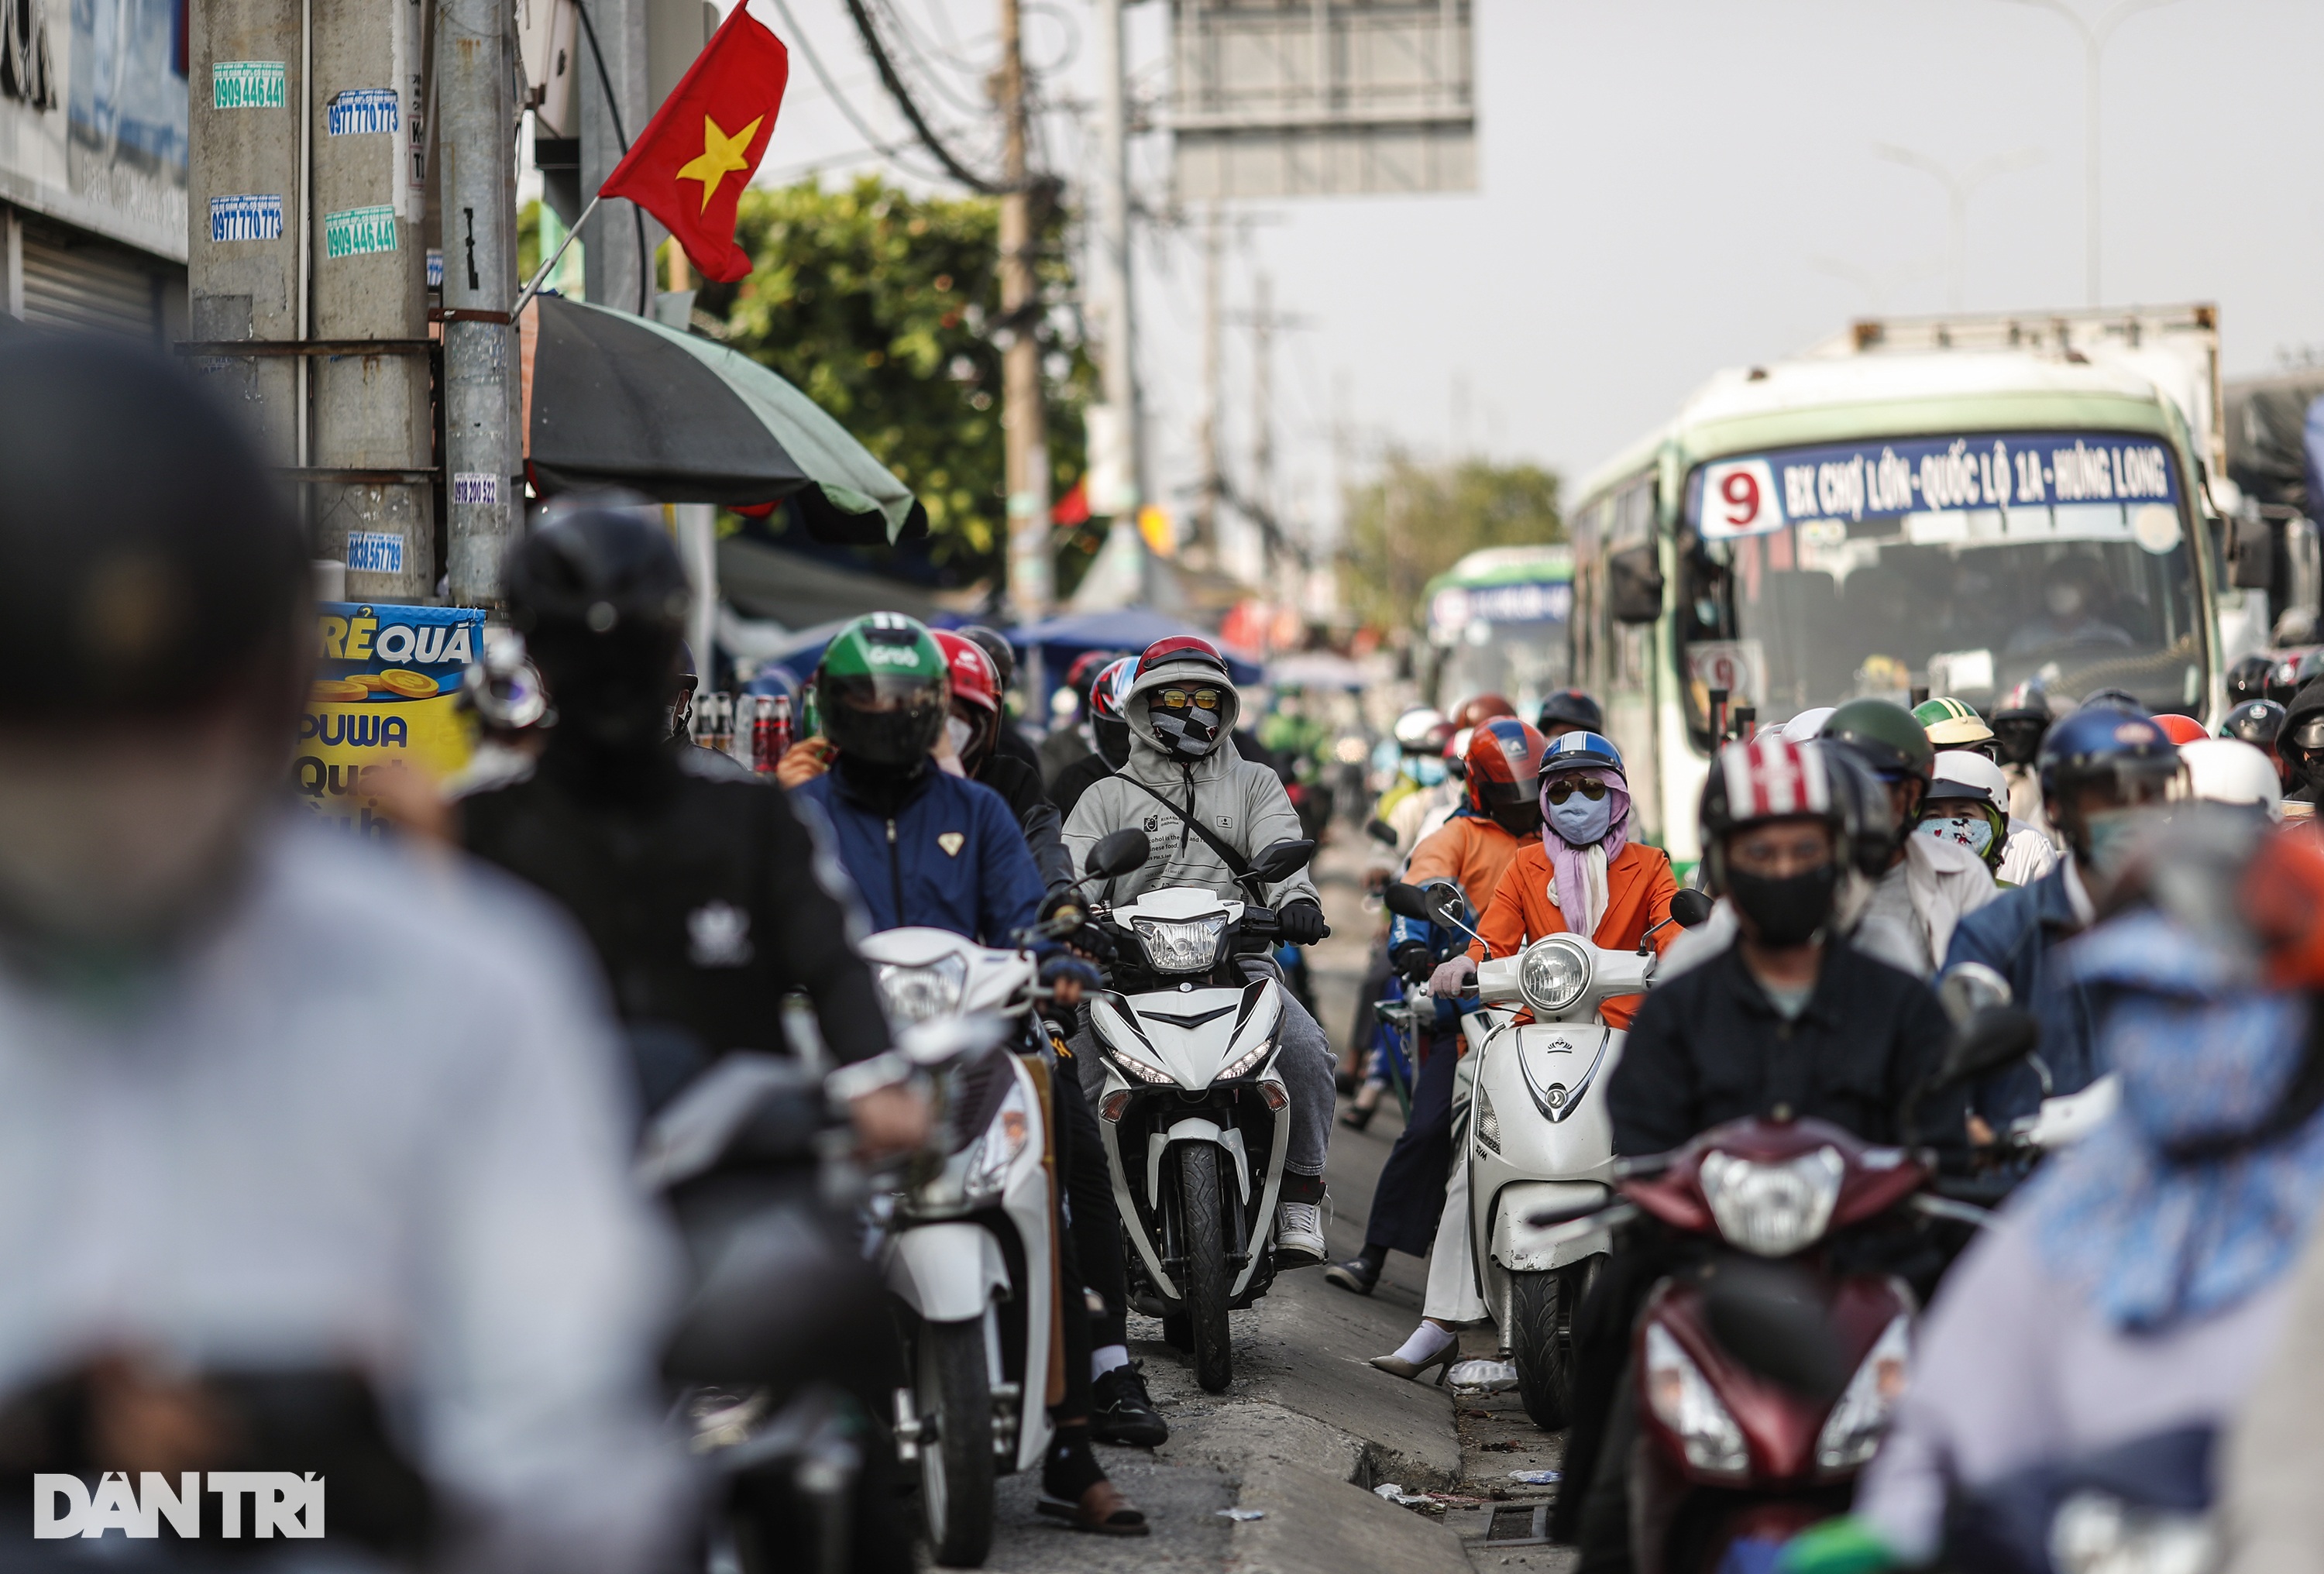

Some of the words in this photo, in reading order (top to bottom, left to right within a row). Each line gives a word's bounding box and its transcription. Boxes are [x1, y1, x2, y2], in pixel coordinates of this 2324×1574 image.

[1721, 472, 1759, 526] 9
[1783, 465, 1818, 517] BX
[1818, 453, 1865, 522] CHỢ
[1865, 445, 1913, 511] LỚN
[1920, 438, 1980, 512] QUỐC
[1980, 439, 2012, 510] LỘ
[2015, 449, 2046, 503] 1A
[2112, 446, 2168, 498] LONG
[318, 607, 377, 660] RẺ
[376, 622, 473, 666] QUÁ
[296, 713, 407, 748] PUWA
[1475, 1144, 1488, 1162] SYM
